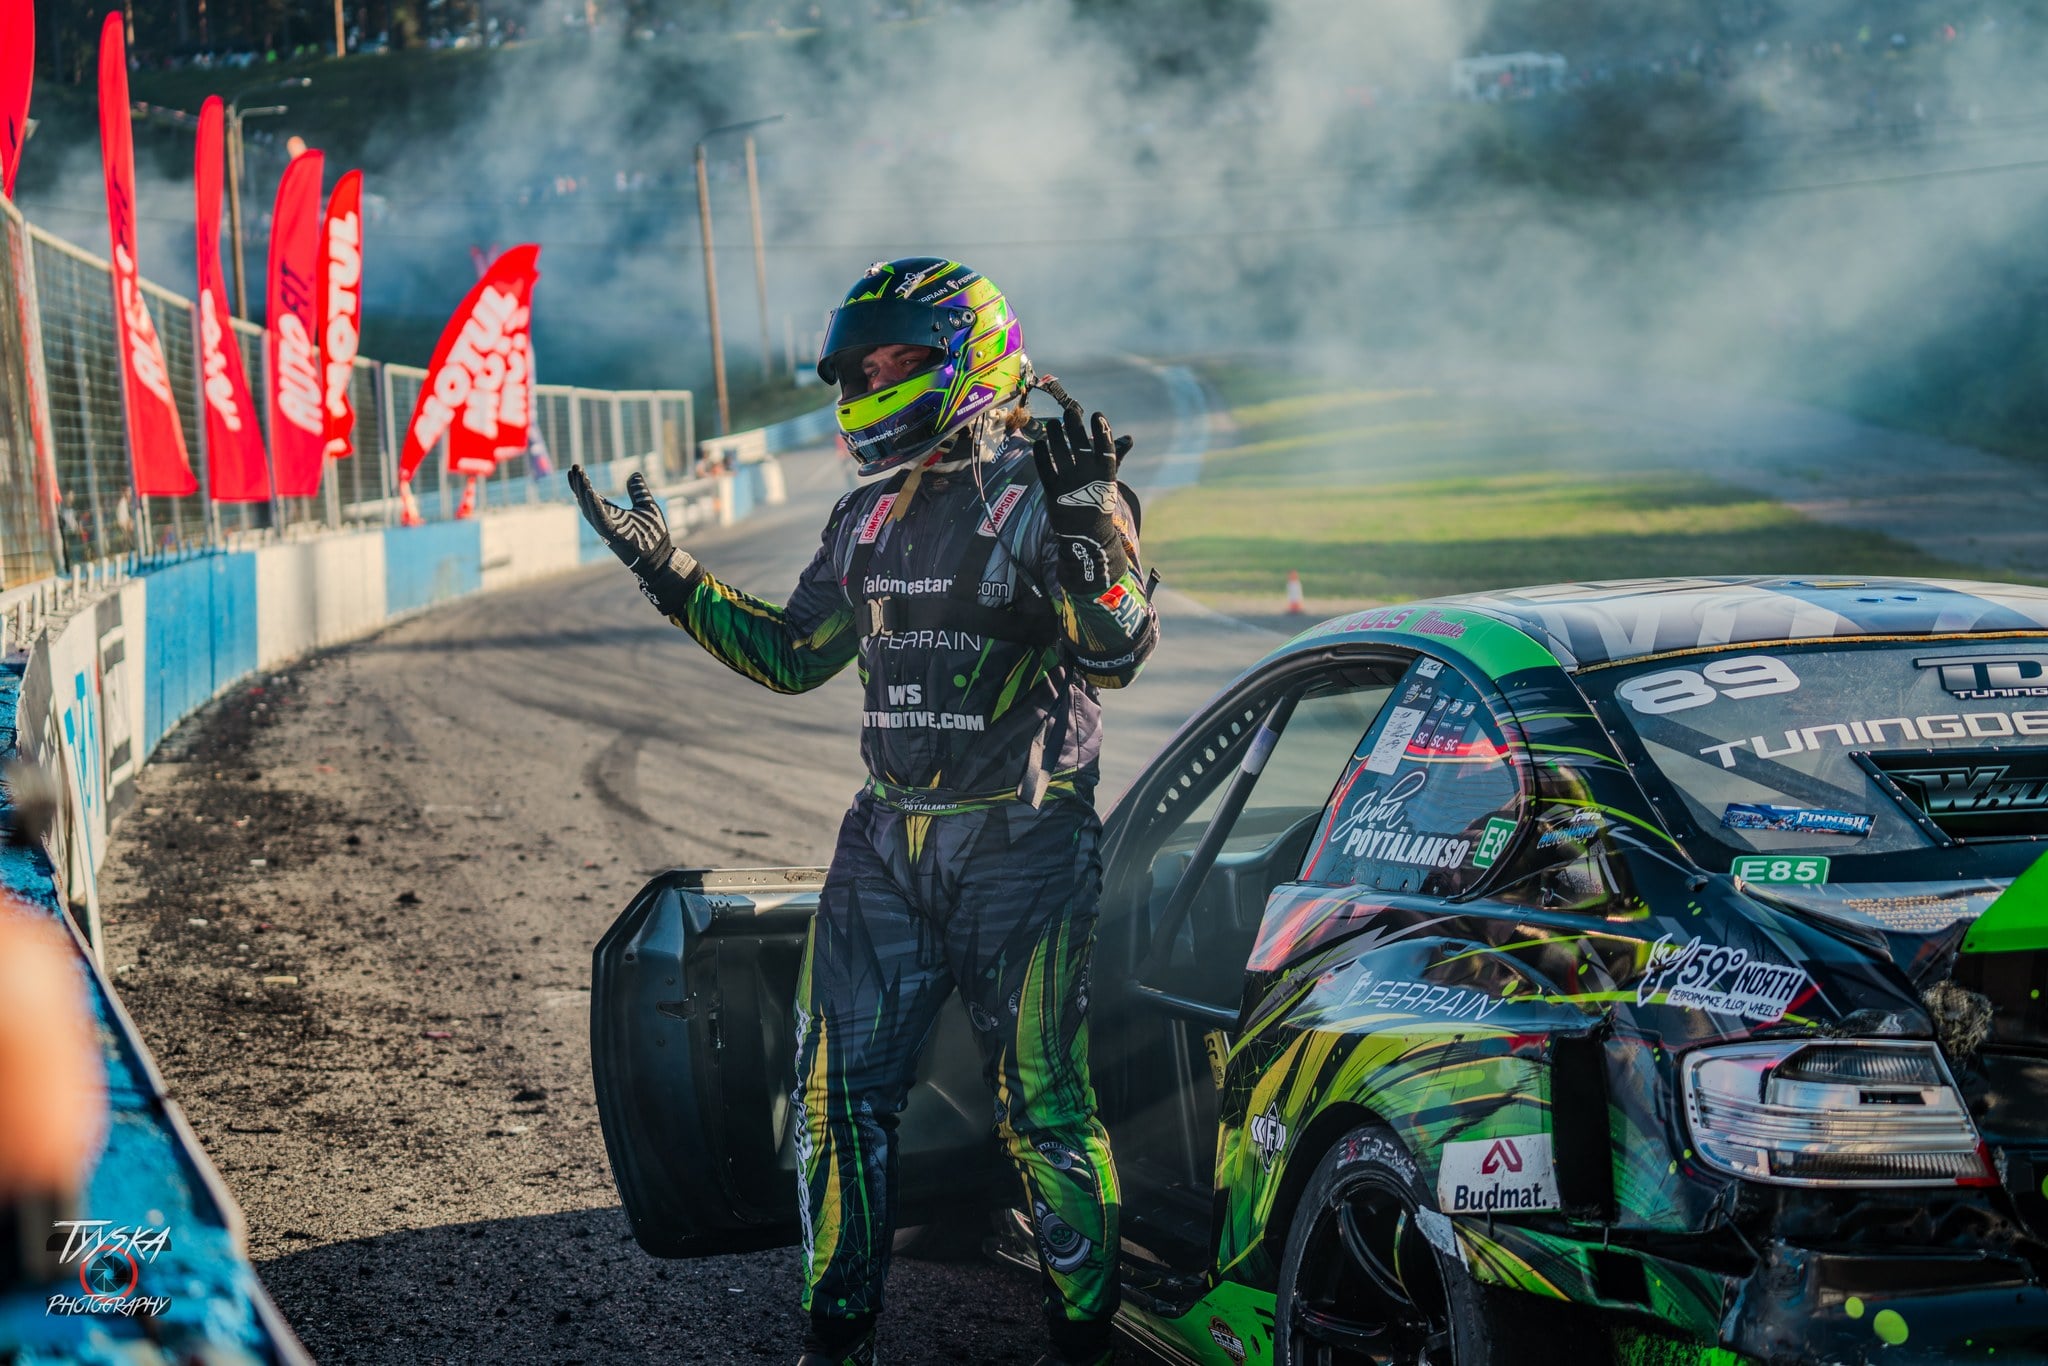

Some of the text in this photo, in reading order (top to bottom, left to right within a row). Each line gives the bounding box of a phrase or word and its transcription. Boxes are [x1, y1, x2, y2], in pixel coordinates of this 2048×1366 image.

[415, 285, 518, 451] MOTUL
[865, 500, 890, 538] SIMPSON
[986, 491, 1018, 530] SIMPSON
[888, 684, 922, 706] WS
[1619, 655, 1801, 715] 89
[1330, 771, 1426, 843] Juha
[1797, 812, 1867, 830] FINNISH
[1740, 861, 1818, 881] E85
[1359, 980, 1505, 1022] FERRAIN
[1735, 965, 1804, 1001] NORTH
[1671, 989, 1782, 1018] PERFORMANCE ALLOY WHEELS
[1454, 1183, 1547, 1210] Budmat.
